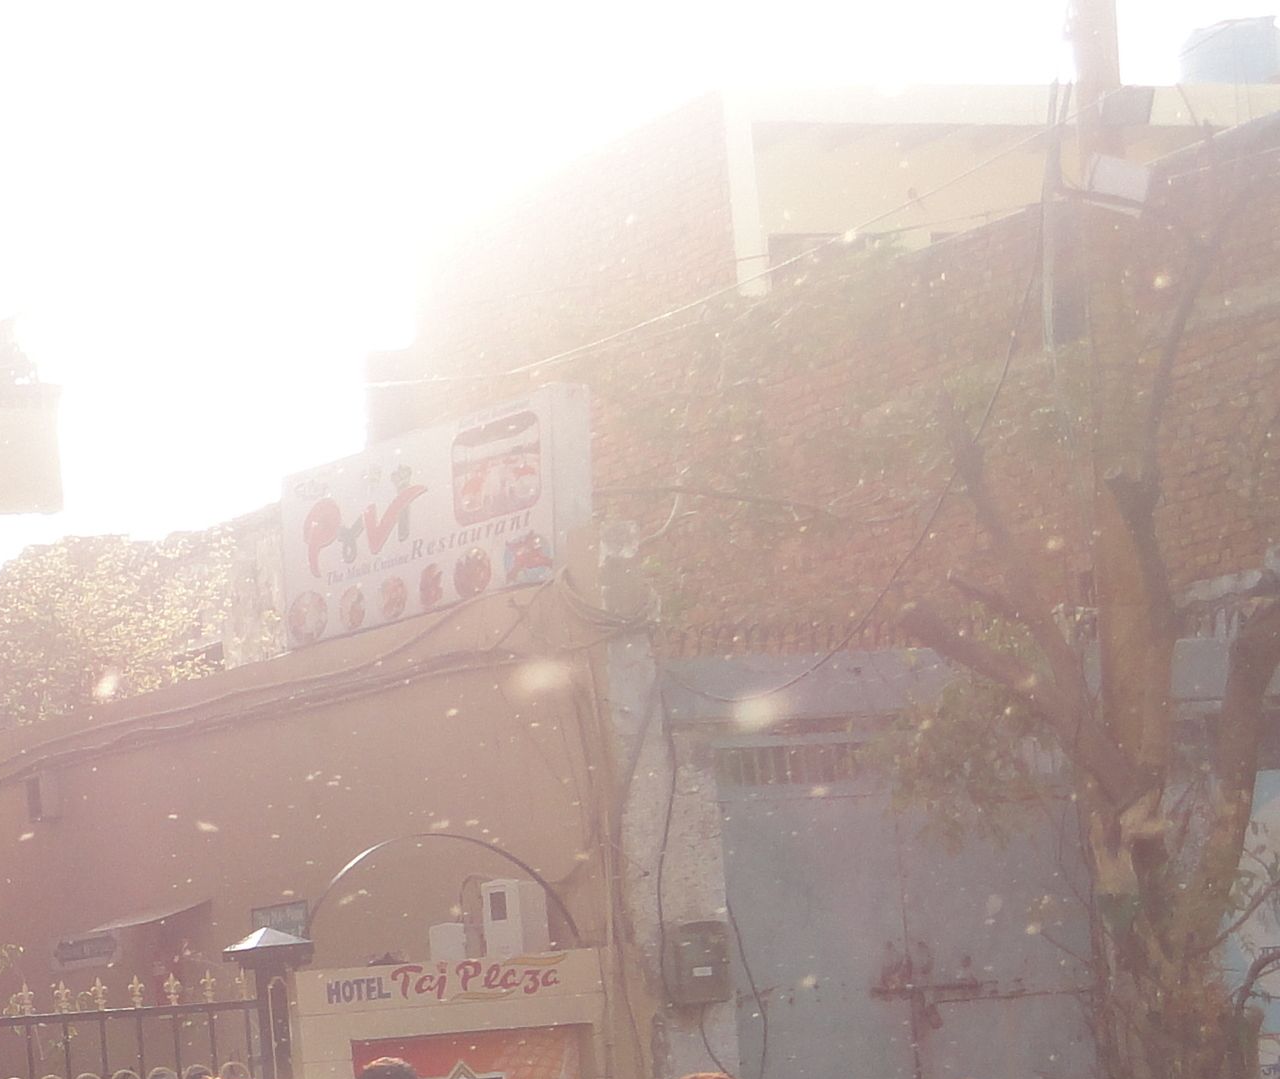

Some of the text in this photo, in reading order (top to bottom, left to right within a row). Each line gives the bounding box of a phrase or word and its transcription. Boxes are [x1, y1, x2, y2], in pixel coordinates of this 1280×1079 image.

[410, 509, 532, 560] Restaurant
[326, 959, 561, 1005] HOTEL Taj Plaza
